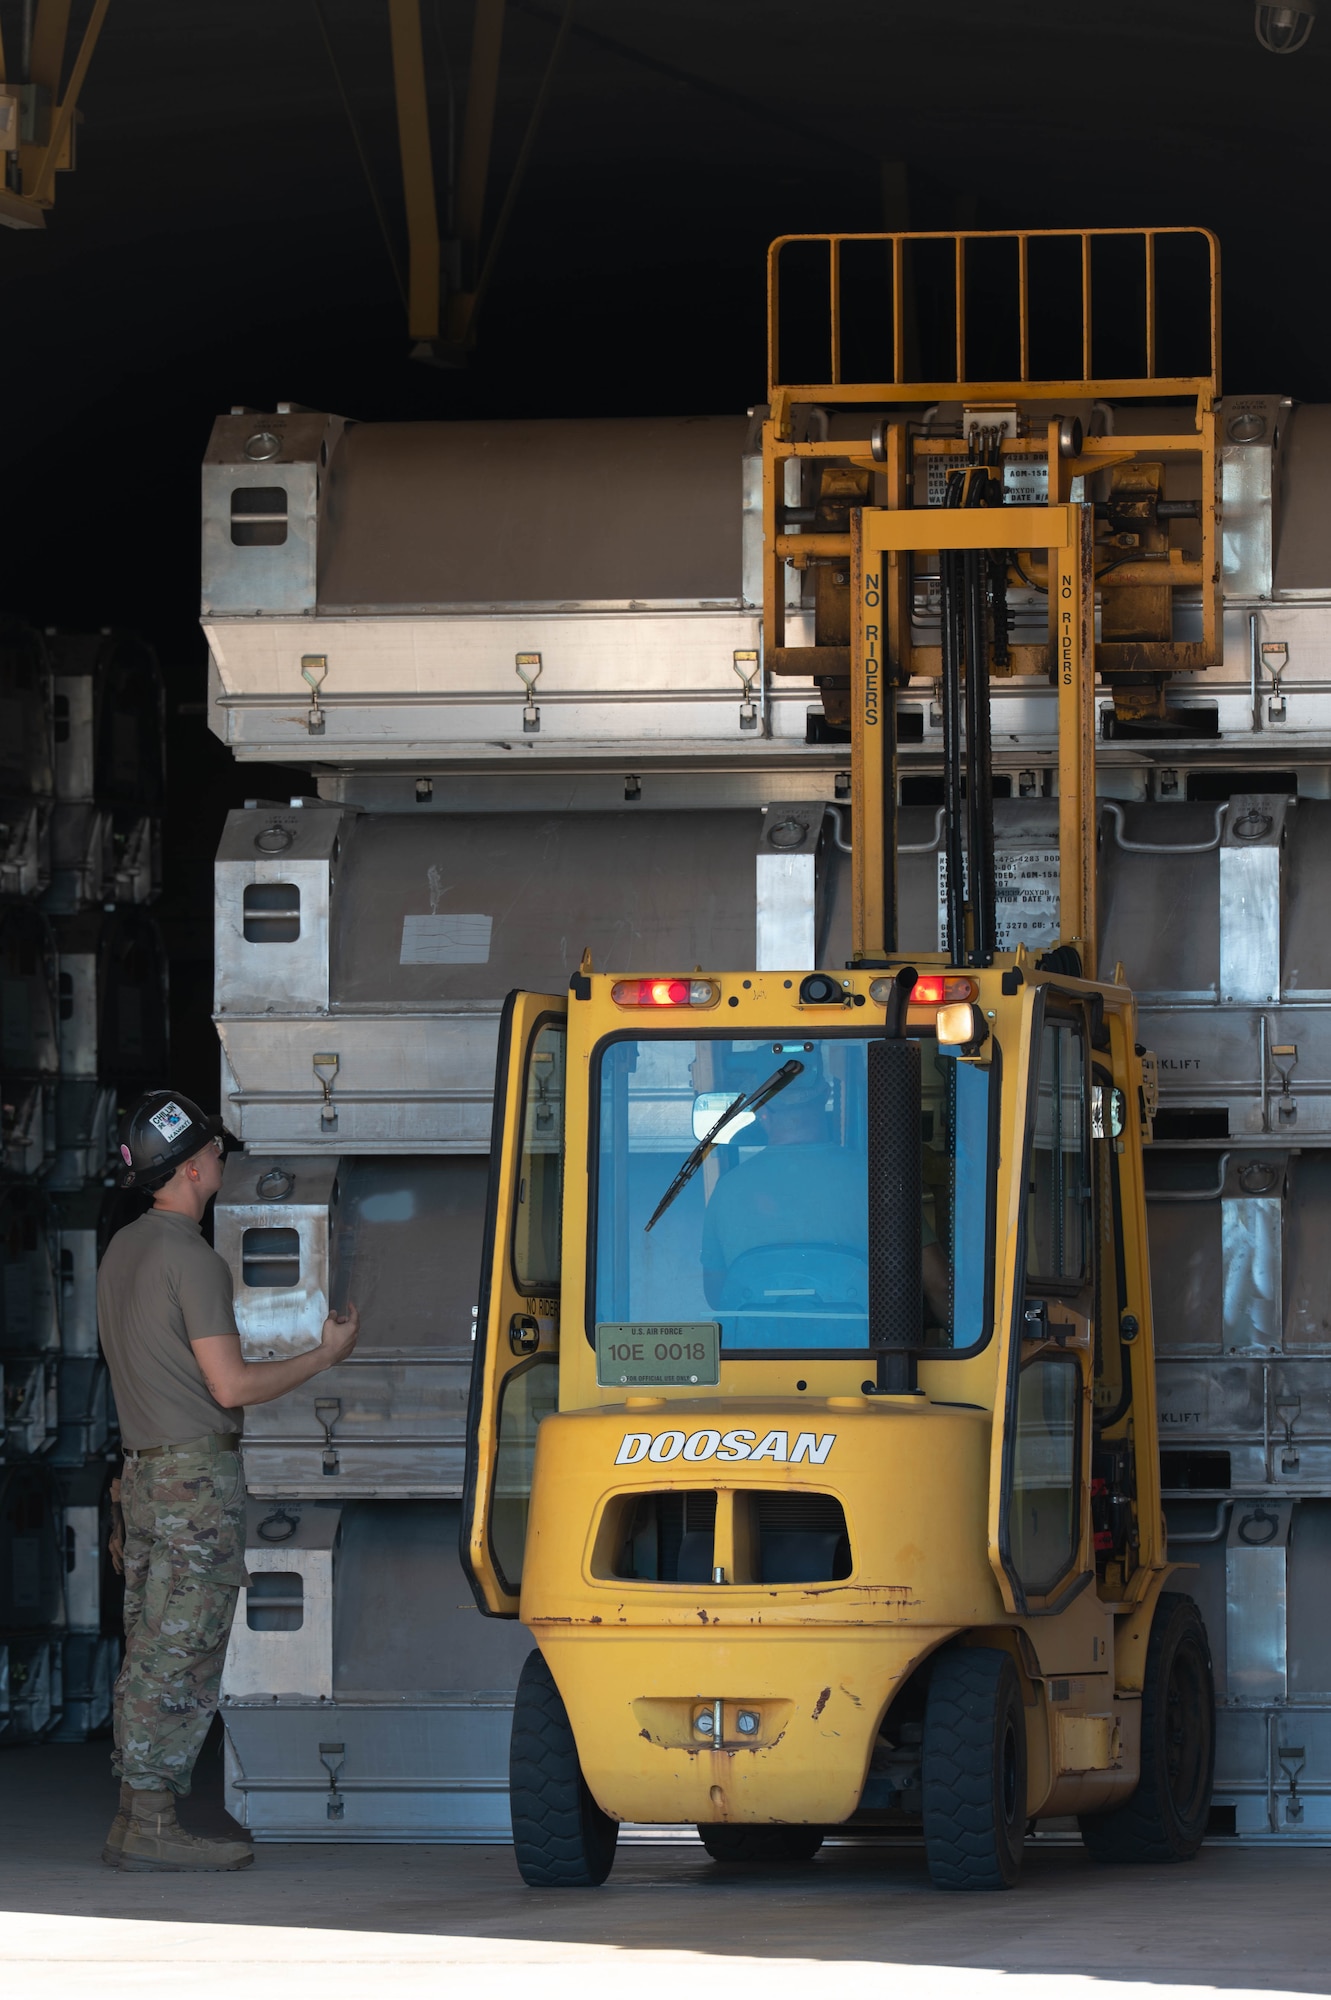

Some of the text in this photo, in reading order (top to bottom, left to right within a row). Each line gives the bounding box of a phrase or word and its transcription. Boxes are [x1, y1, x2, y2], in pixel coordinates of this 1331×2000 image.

[1010, 470, 1048, 478] AGM-158
[865, 573, 880, 607] NO
[1062, 575, 1072, 599] NO
[1062, 612, 1072, 685] RIDERS
[865, 625, 879, 726] RIDERS
[1021, 871, 1060, 879] AGM-158
[526, 1298, 537, 1315] NO
[632, 1327, 683, 1336] U.S. AIR FORCE
[608, 1343, 706, 1361] 10E 0018
[1161, 1412, 1201, 1423] KLIFT
[614, 1430, 838, 1466] DOOSAN
